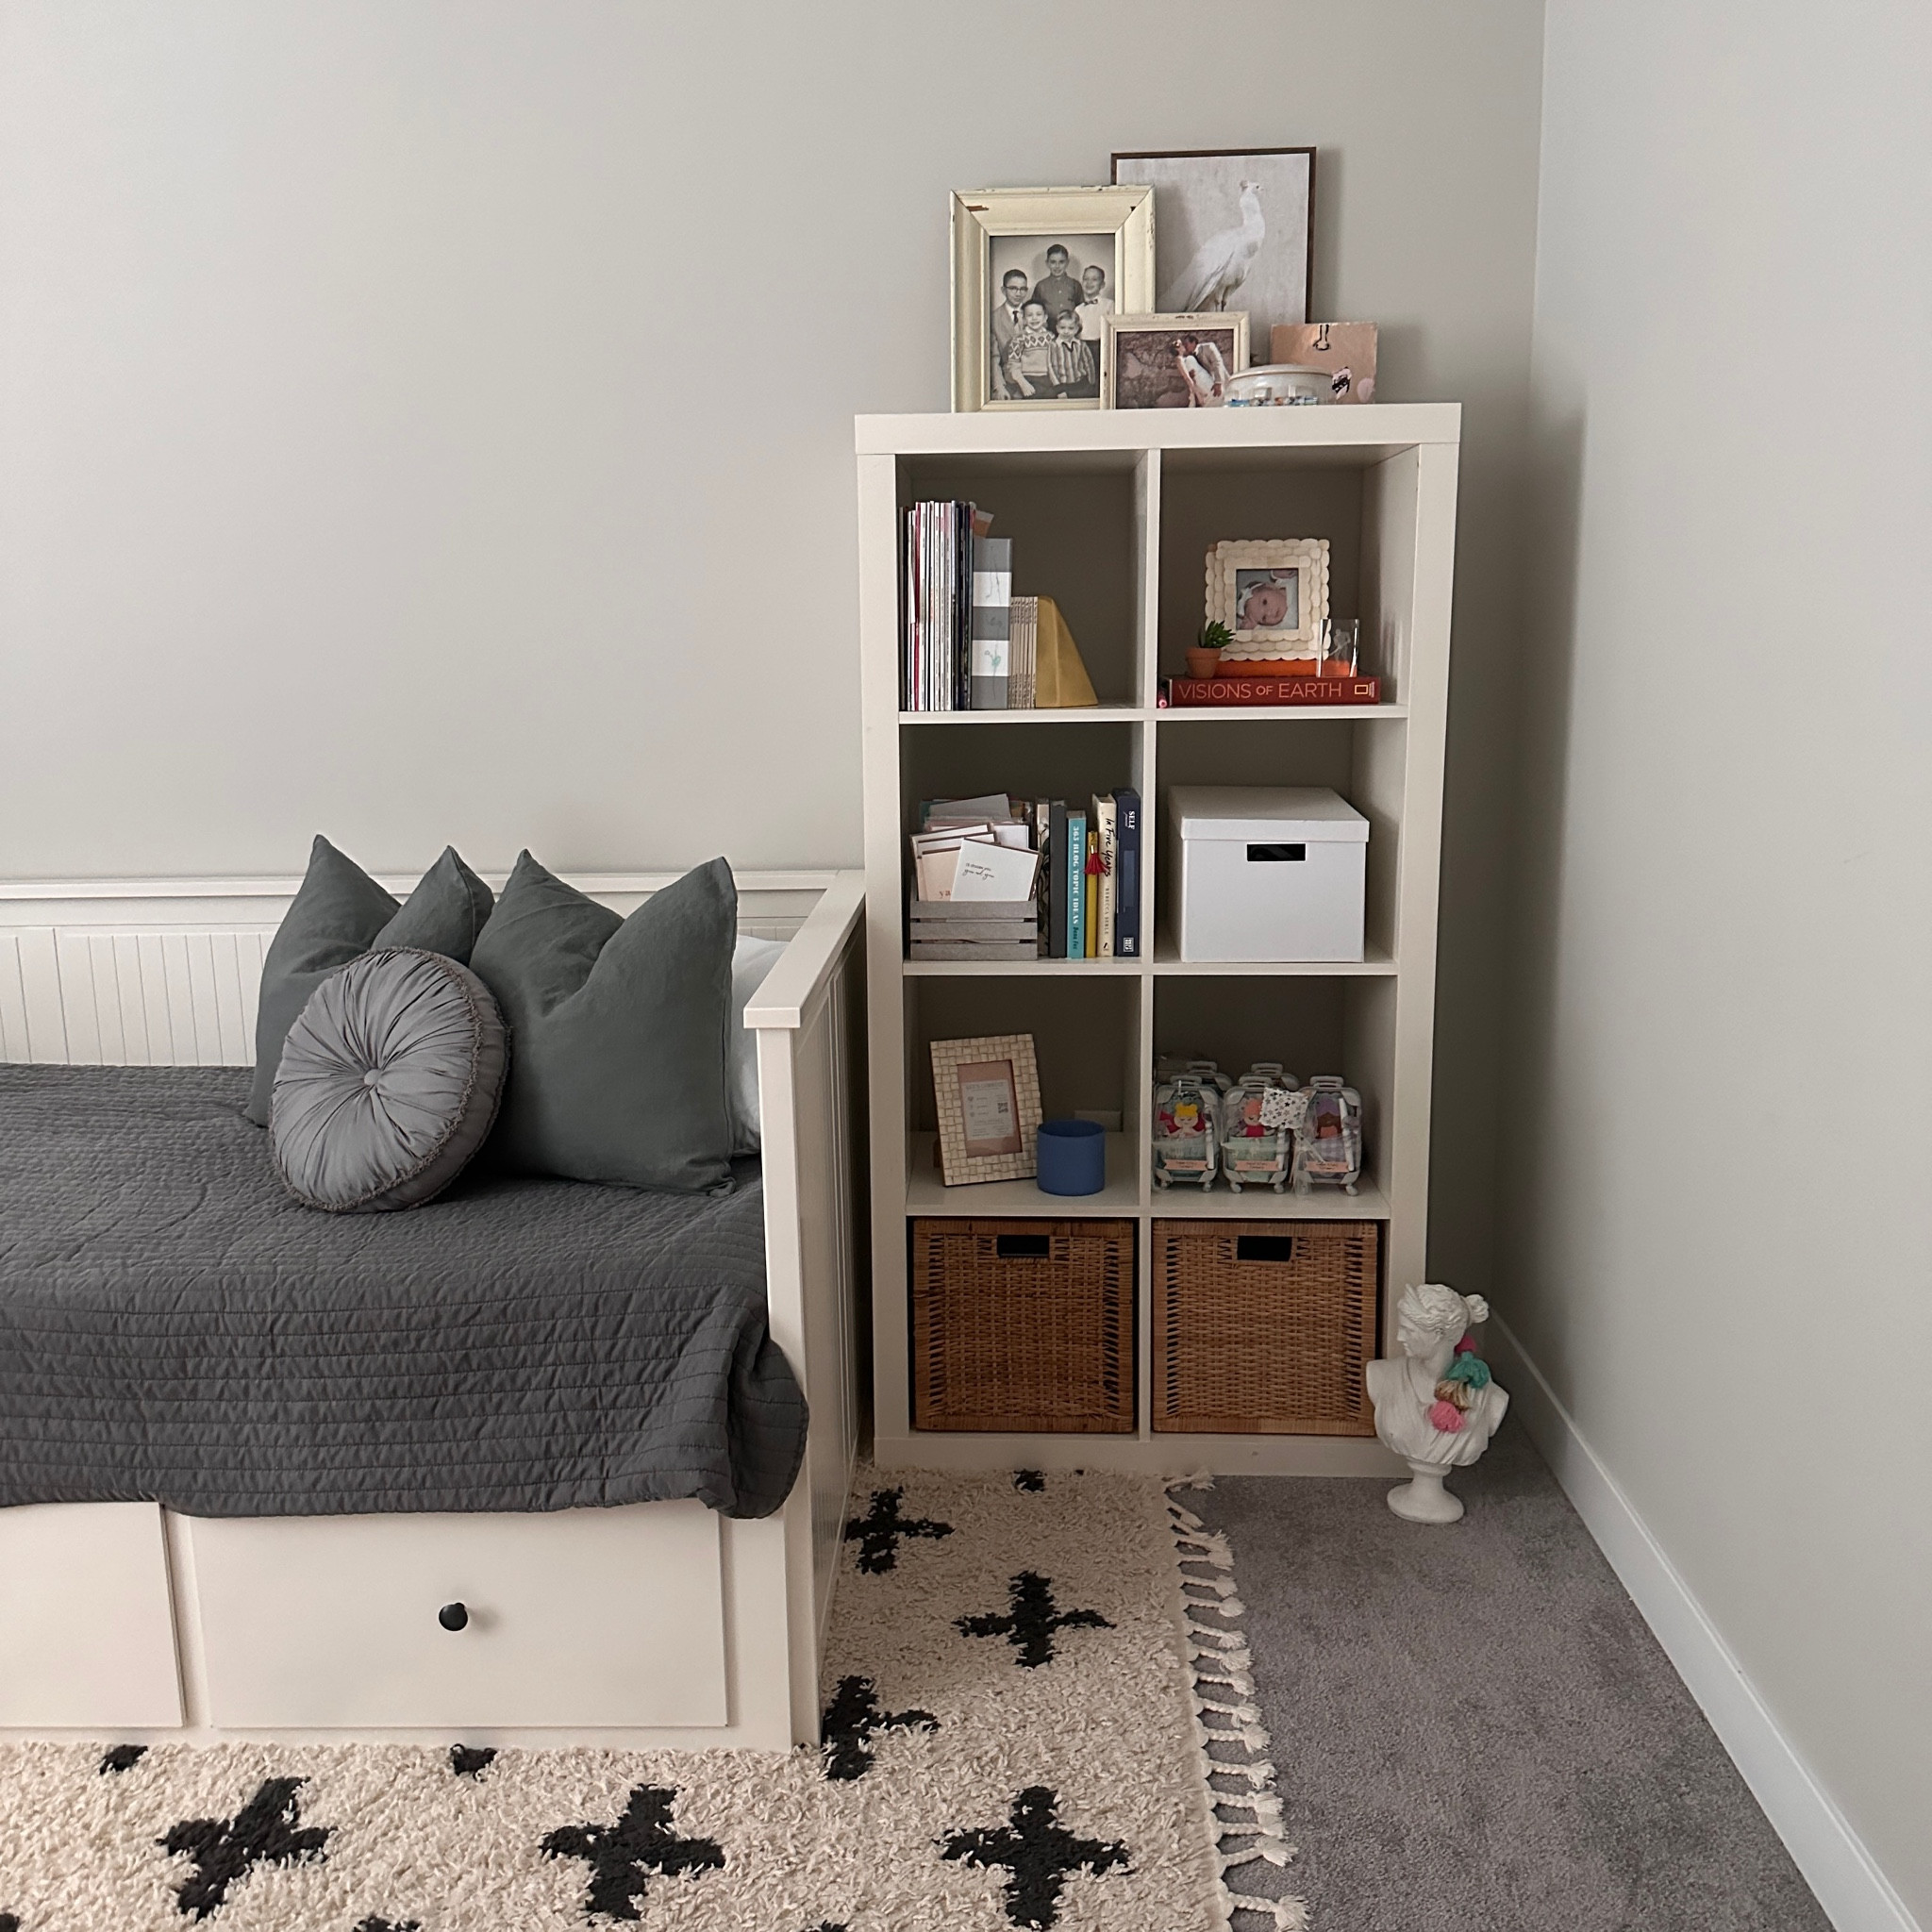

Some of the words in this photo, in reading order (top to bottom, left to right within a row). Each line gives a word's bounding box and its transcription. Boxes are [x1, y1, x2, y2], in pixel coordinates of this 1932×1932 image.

[1179, 683, 1251, 700] VISIONS
[1256, 685, 1274, 696] OF
[1278, 682, 1341, 698] EARTH
[1105, 829, 1115, 848] Five
[1101, 850, 1114, 877] Years
